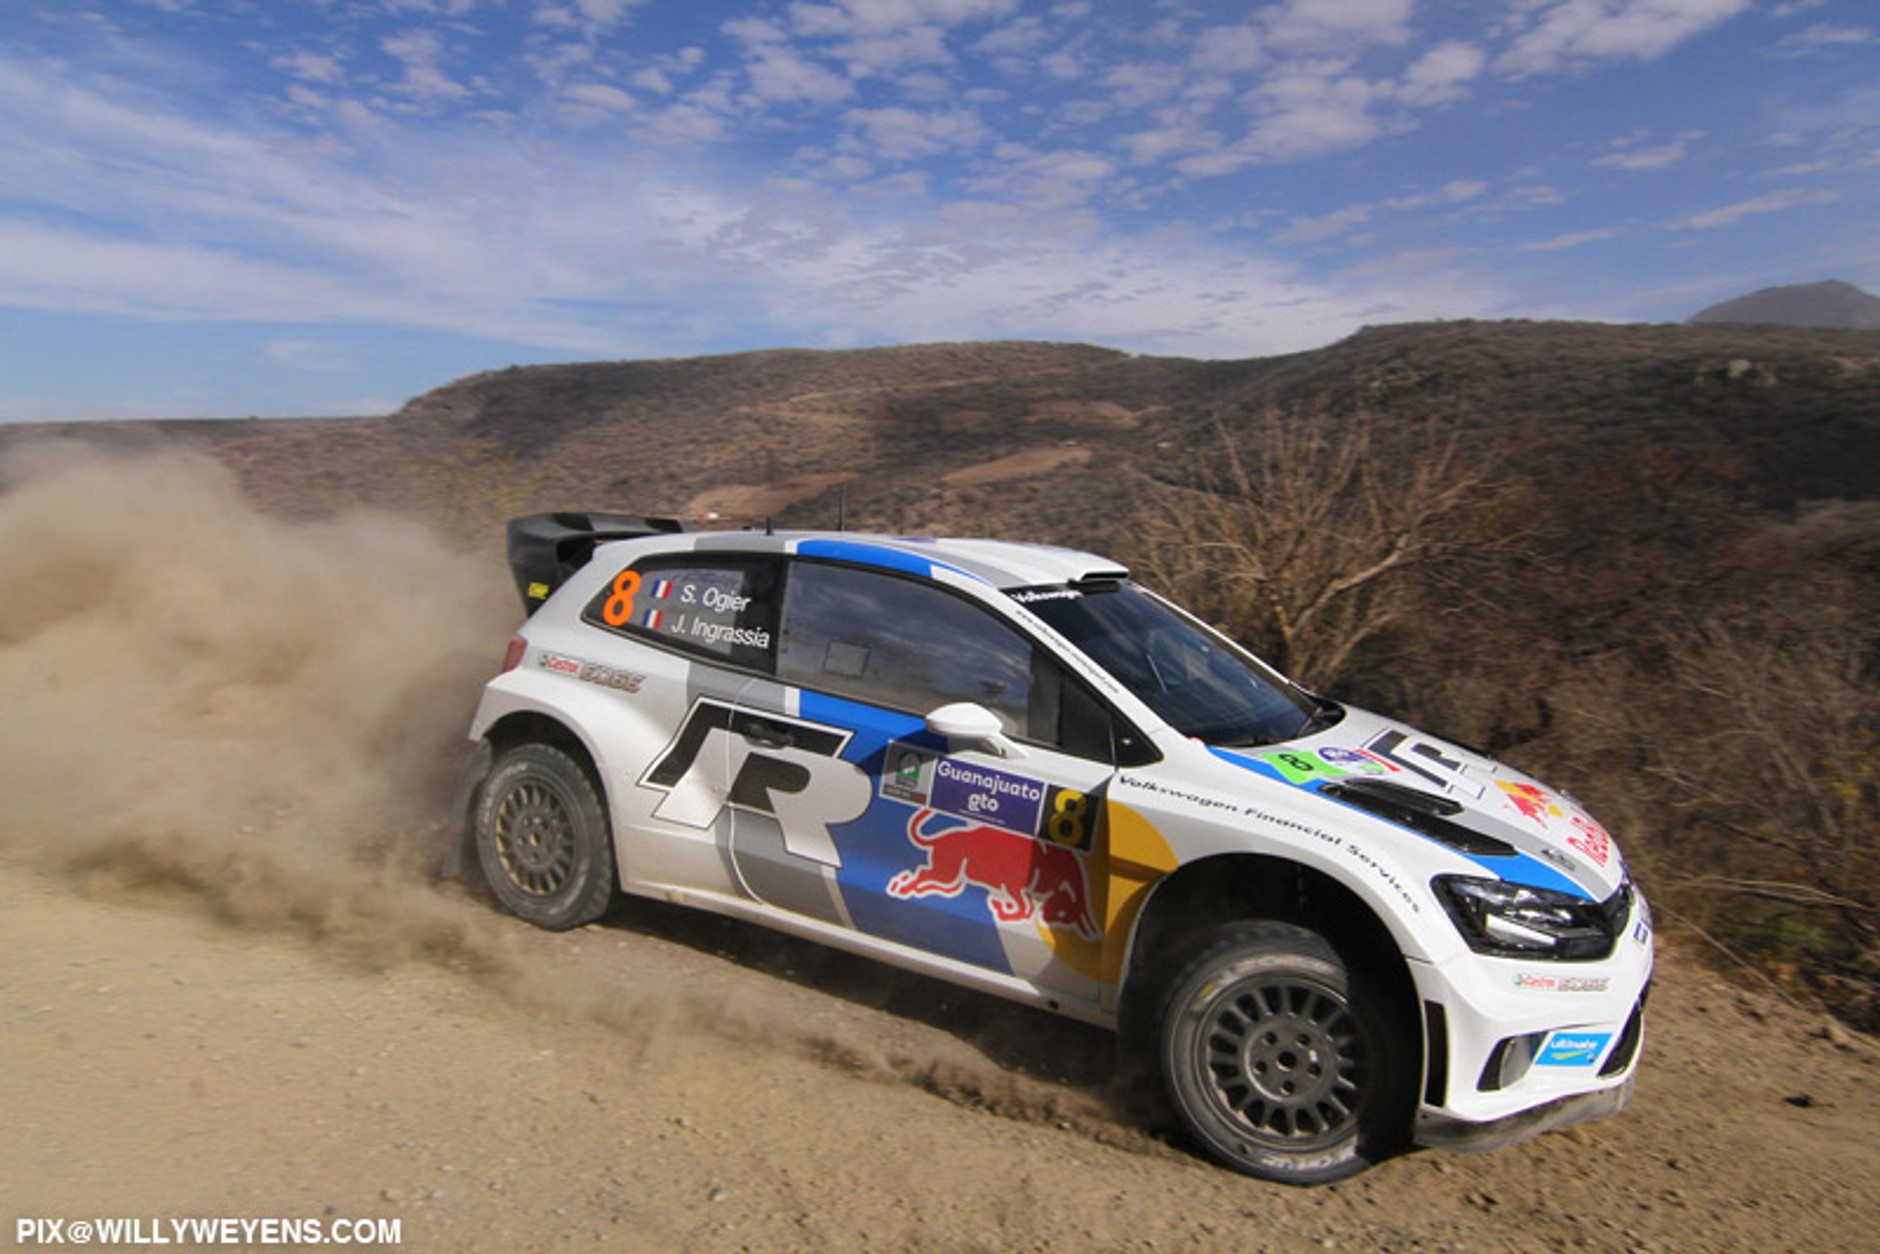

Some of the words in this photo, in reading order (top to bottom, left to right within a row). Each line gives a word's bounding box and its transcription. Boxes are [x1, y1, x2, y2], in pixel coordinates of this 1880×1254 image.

[603, 569, 641, 626] 8
[681, 584, 697, 605] S.
[702, 587, 752, 613] Ogier
[671, 614, 687, 635] J.
[691, 617, 770, 649] Ingrassia
[936, 760, 1040, 801] Guanajuato
[1278, 753, 1314, 771] 8
[650, 725, 874, 868] R
[967, 792, 1000, 812] gto
[1050, 788, 1086, 846] 8
[1120, 776, 1238, 812] Volkswagen
[1244, 808, 1343, 846] Financial
[1347, 844, 1420, 913] Services
